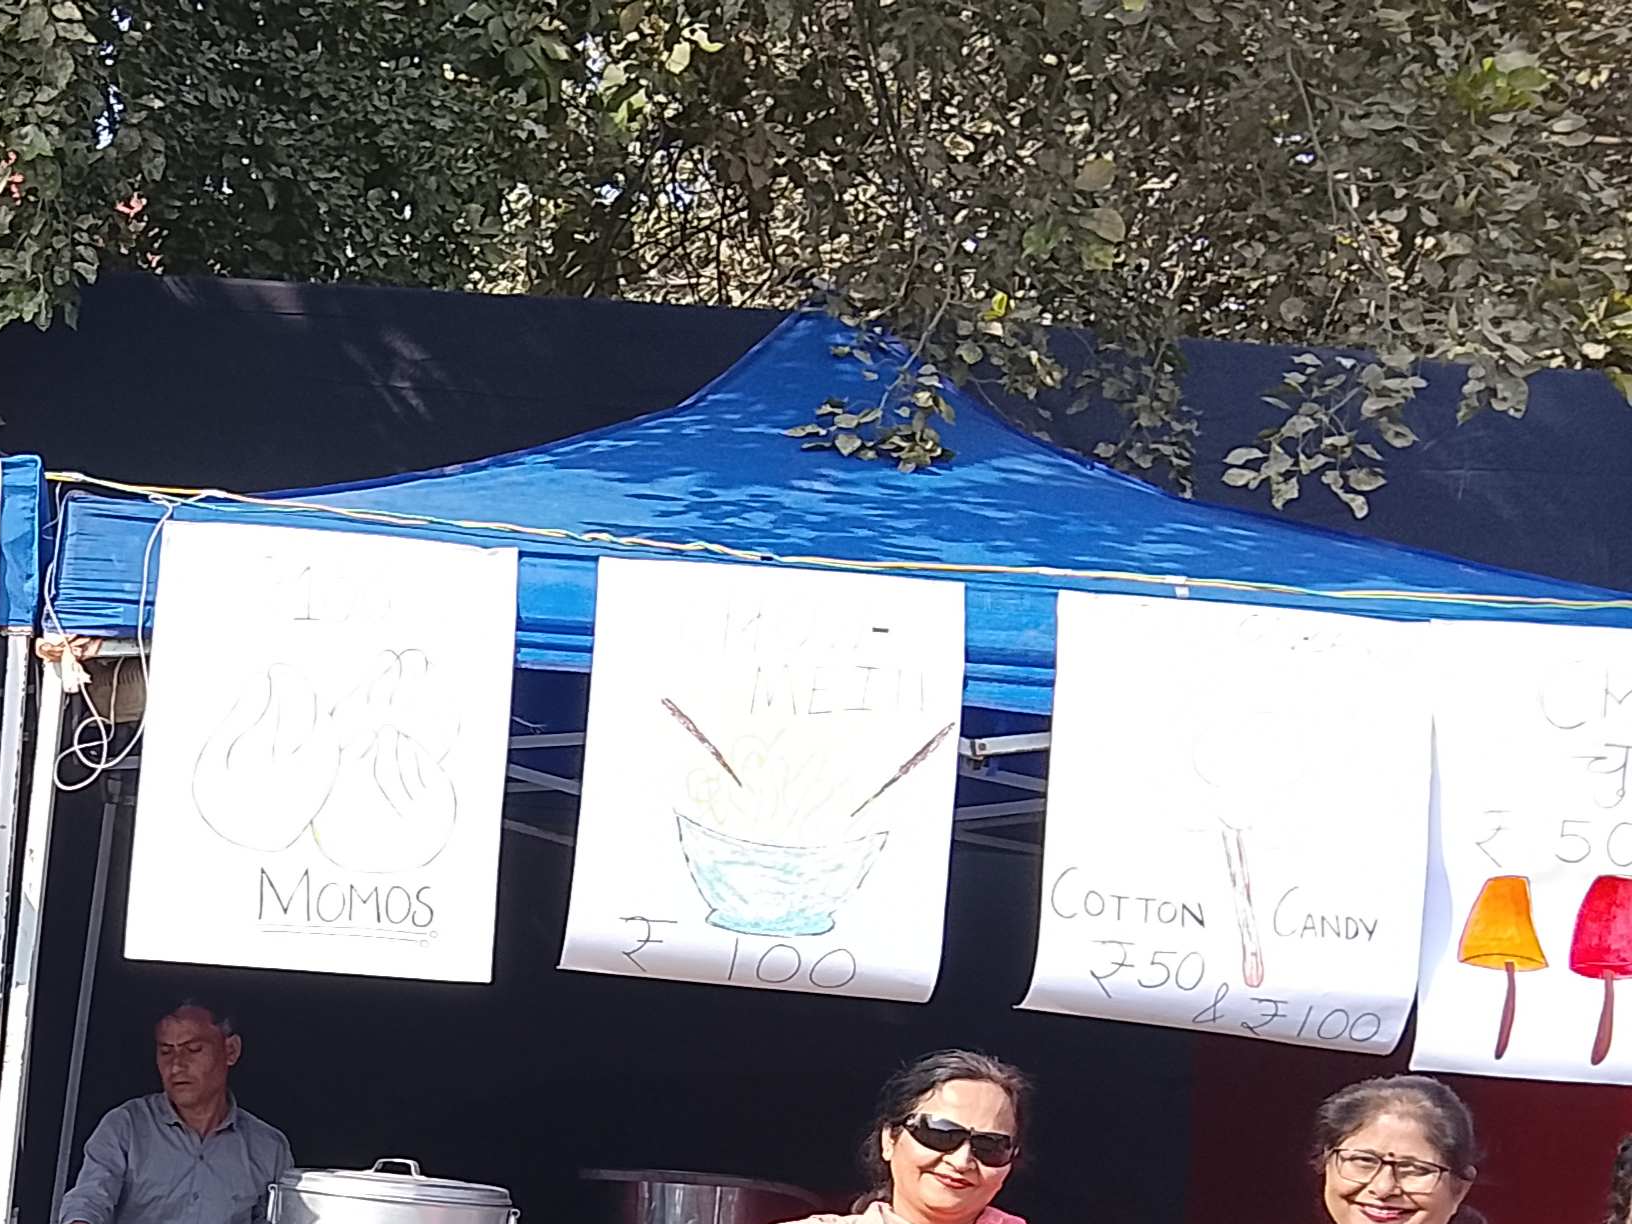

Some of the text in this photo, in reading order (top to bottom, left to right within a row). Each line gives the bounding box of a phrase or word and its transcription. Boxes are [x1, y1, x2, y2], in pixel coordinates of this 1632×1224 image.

[258, 866, 434, 928] MOMOS
[1051, 866, 1378, 941] COTTON CANDY
[727, 937, 857, 989] 100
[1090, 940, 1206, 999] ₹50
[1192, 982, 1381, 1043] & ₹100
